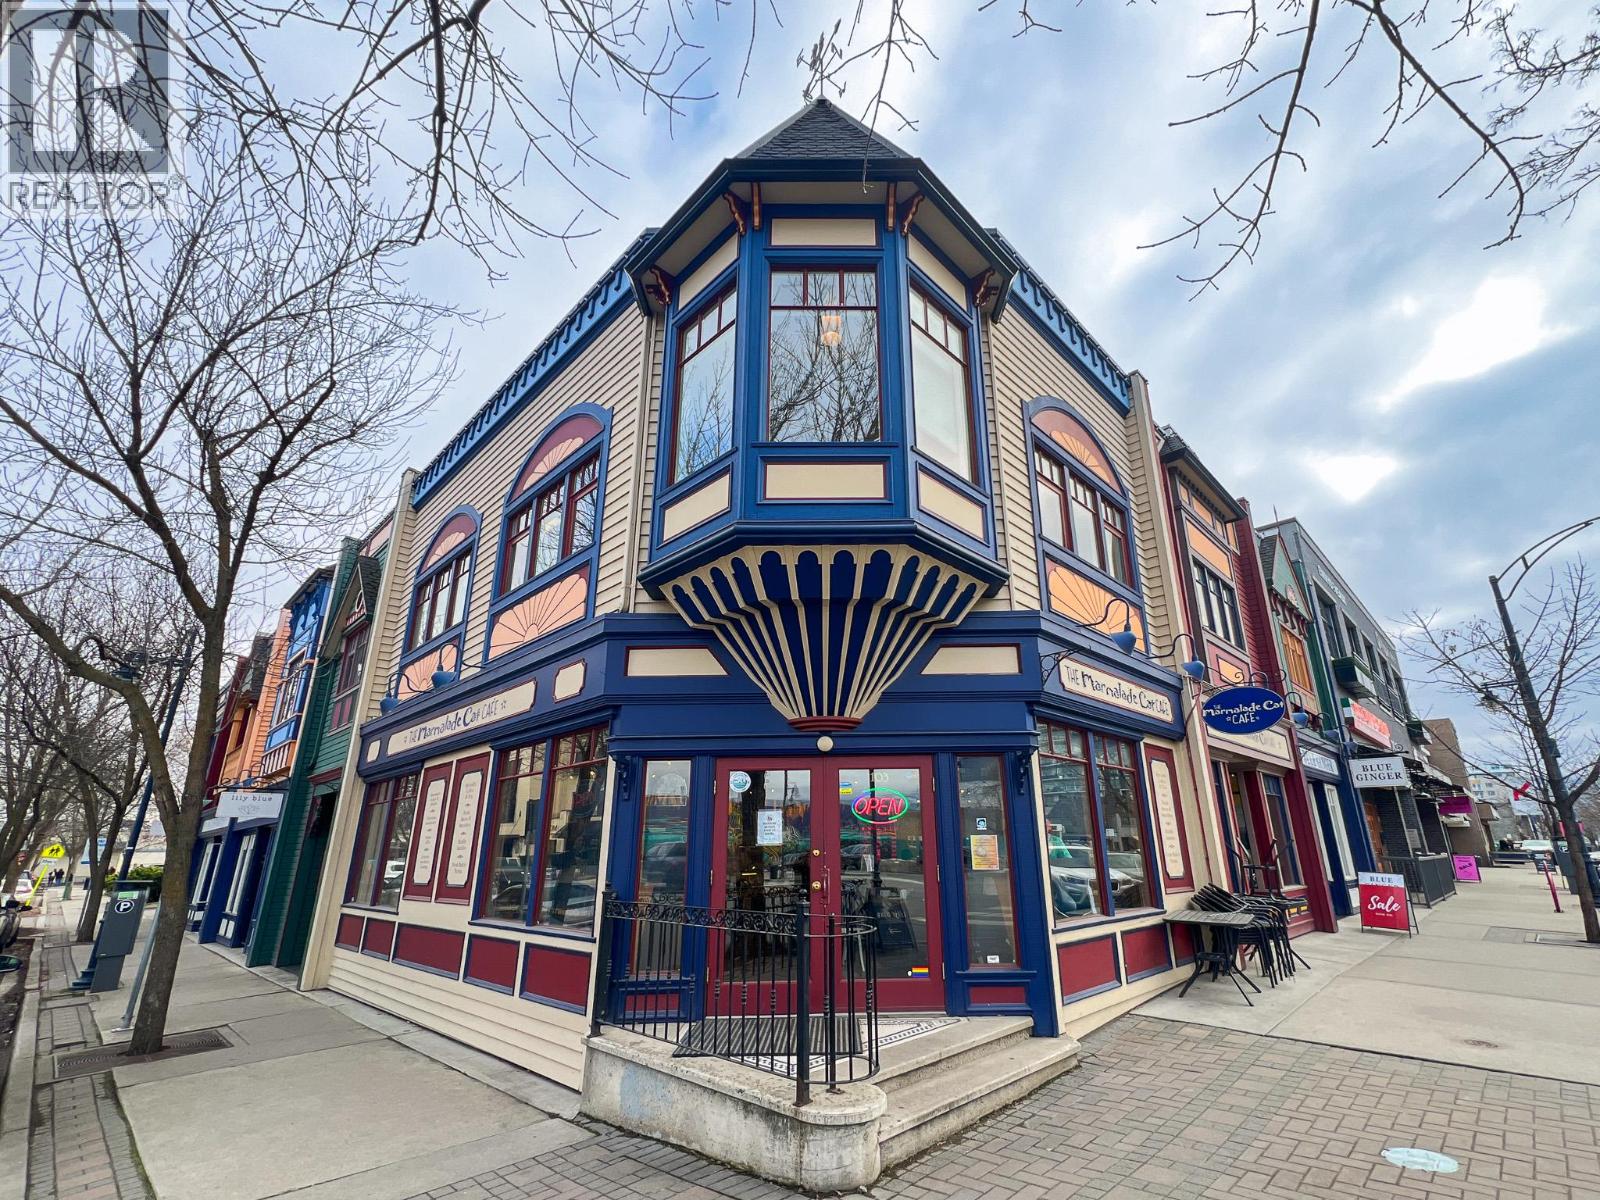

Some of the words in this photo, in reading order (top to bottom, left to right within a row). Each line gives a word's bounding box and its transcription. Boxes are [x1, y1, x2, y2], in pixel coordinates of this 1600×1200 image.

[1064, 665, 1080, 686] THE
[1081, 670, 1138, 705] Marmalade
[1202, 702, 1261, 717] Marmalade
[1262, 699, 1284, 711] Cat
[417, 710, 462, 741] Marmalade
[1361, 763, 1393, 773] BLUE
[1355, 772, 1404, 782] GINGER
[231, 794, 248, 803] lily
[252, 794, 273, 802] blue
[854, 797, 904, 816] OPEN
[1369, 875, 1394, 884] BLUE
[119, 901, 132, 912] P
[1367, 895, 1401, 913] Sale
